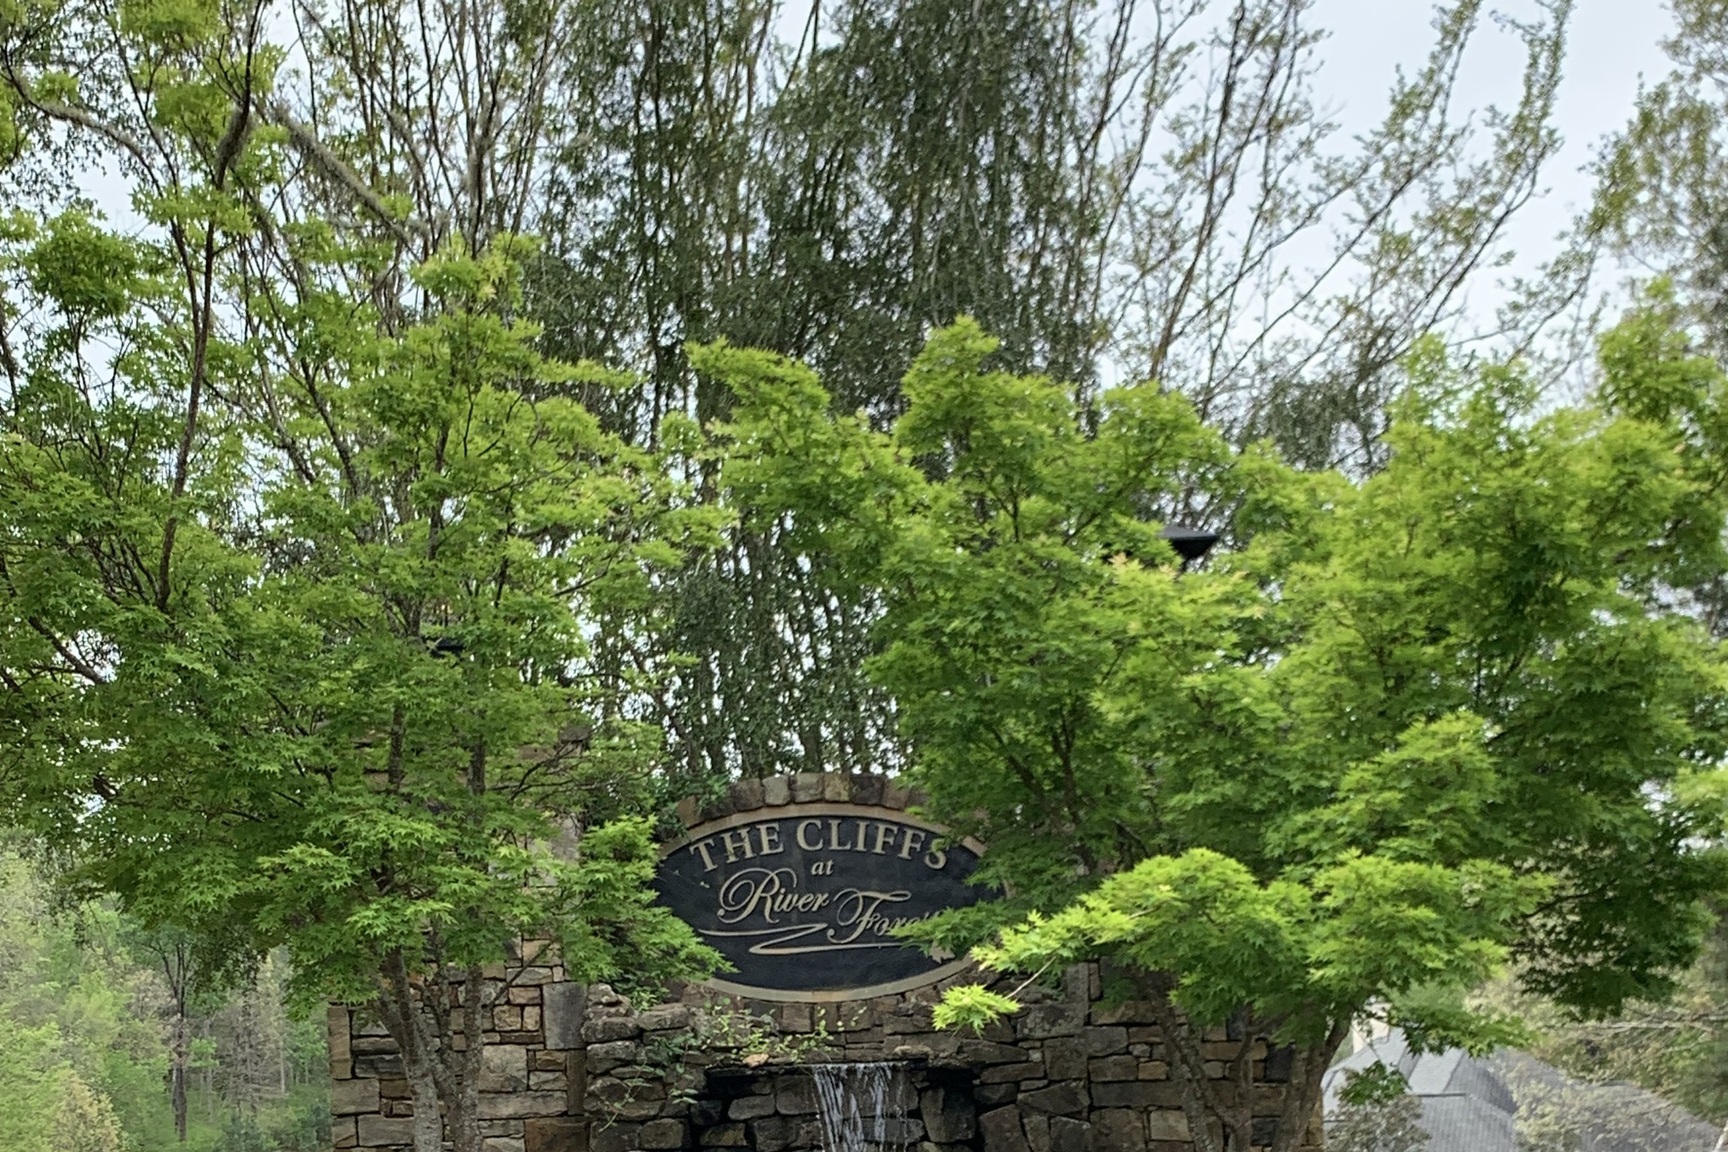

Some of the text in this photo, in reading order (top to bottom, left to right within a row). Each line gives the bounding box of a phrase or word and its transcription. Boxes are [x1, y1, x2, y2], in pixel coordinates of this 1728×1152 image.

[689, 819, 949, 873] THE CLIFFS
[811, 859, 834, 876] at
[716, 867, 830, 924] River
